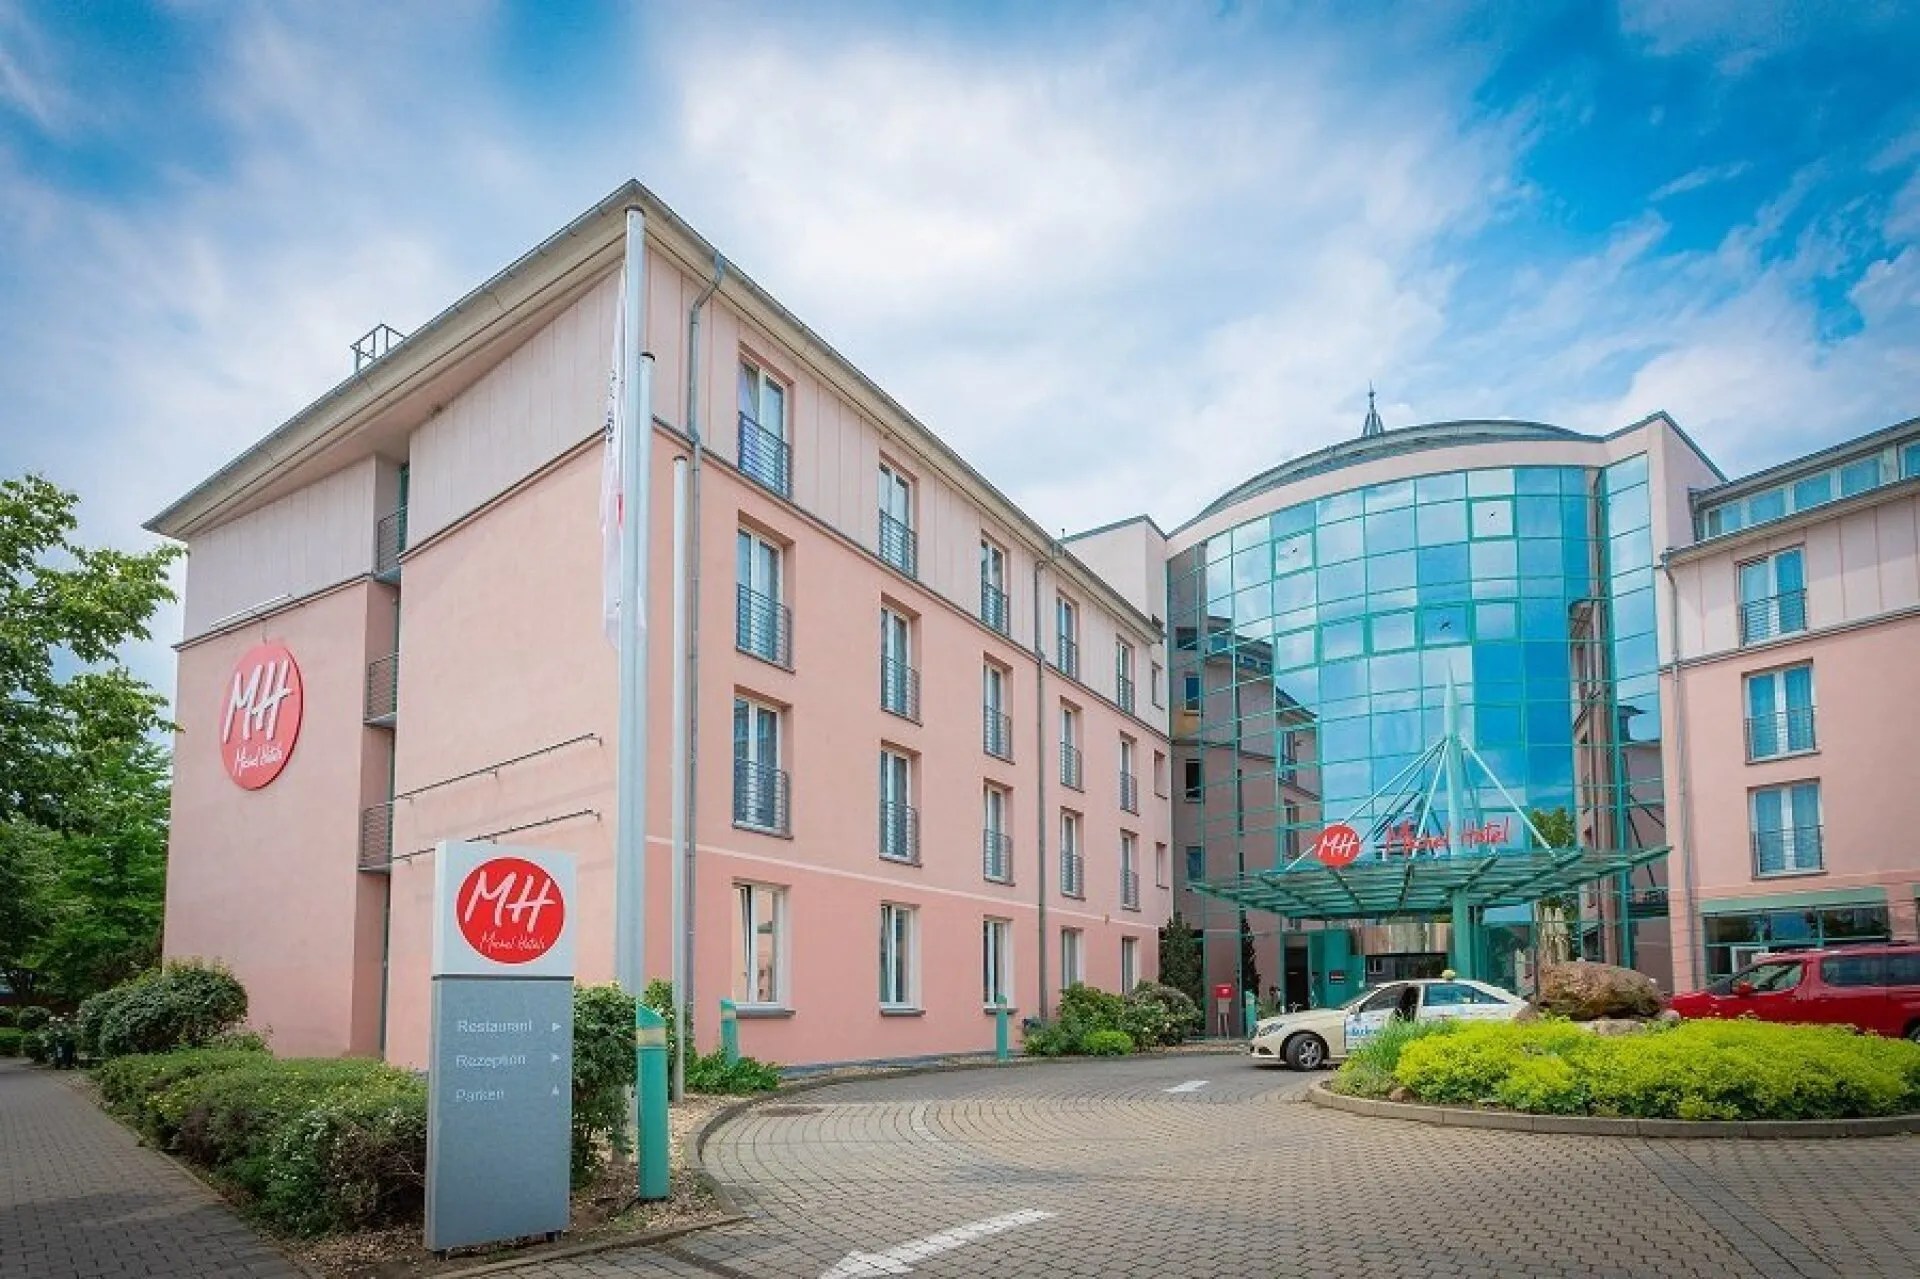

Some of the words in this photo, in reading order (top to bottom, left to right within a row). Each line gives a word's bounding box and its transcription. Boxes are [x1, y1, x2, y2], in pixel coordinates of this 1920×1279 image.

[223, 660, 293, 744] MH
[1318, 832, 1356, 857] MH
[1461, 816, 1508, 848] Hotel
[464, 870, 556, 932] MH
[458, 1019, 532, 1033] Restaurant
[456, 1054, 526, 1069] Rezeption
[456, 1088, 504, 1102] Parken
